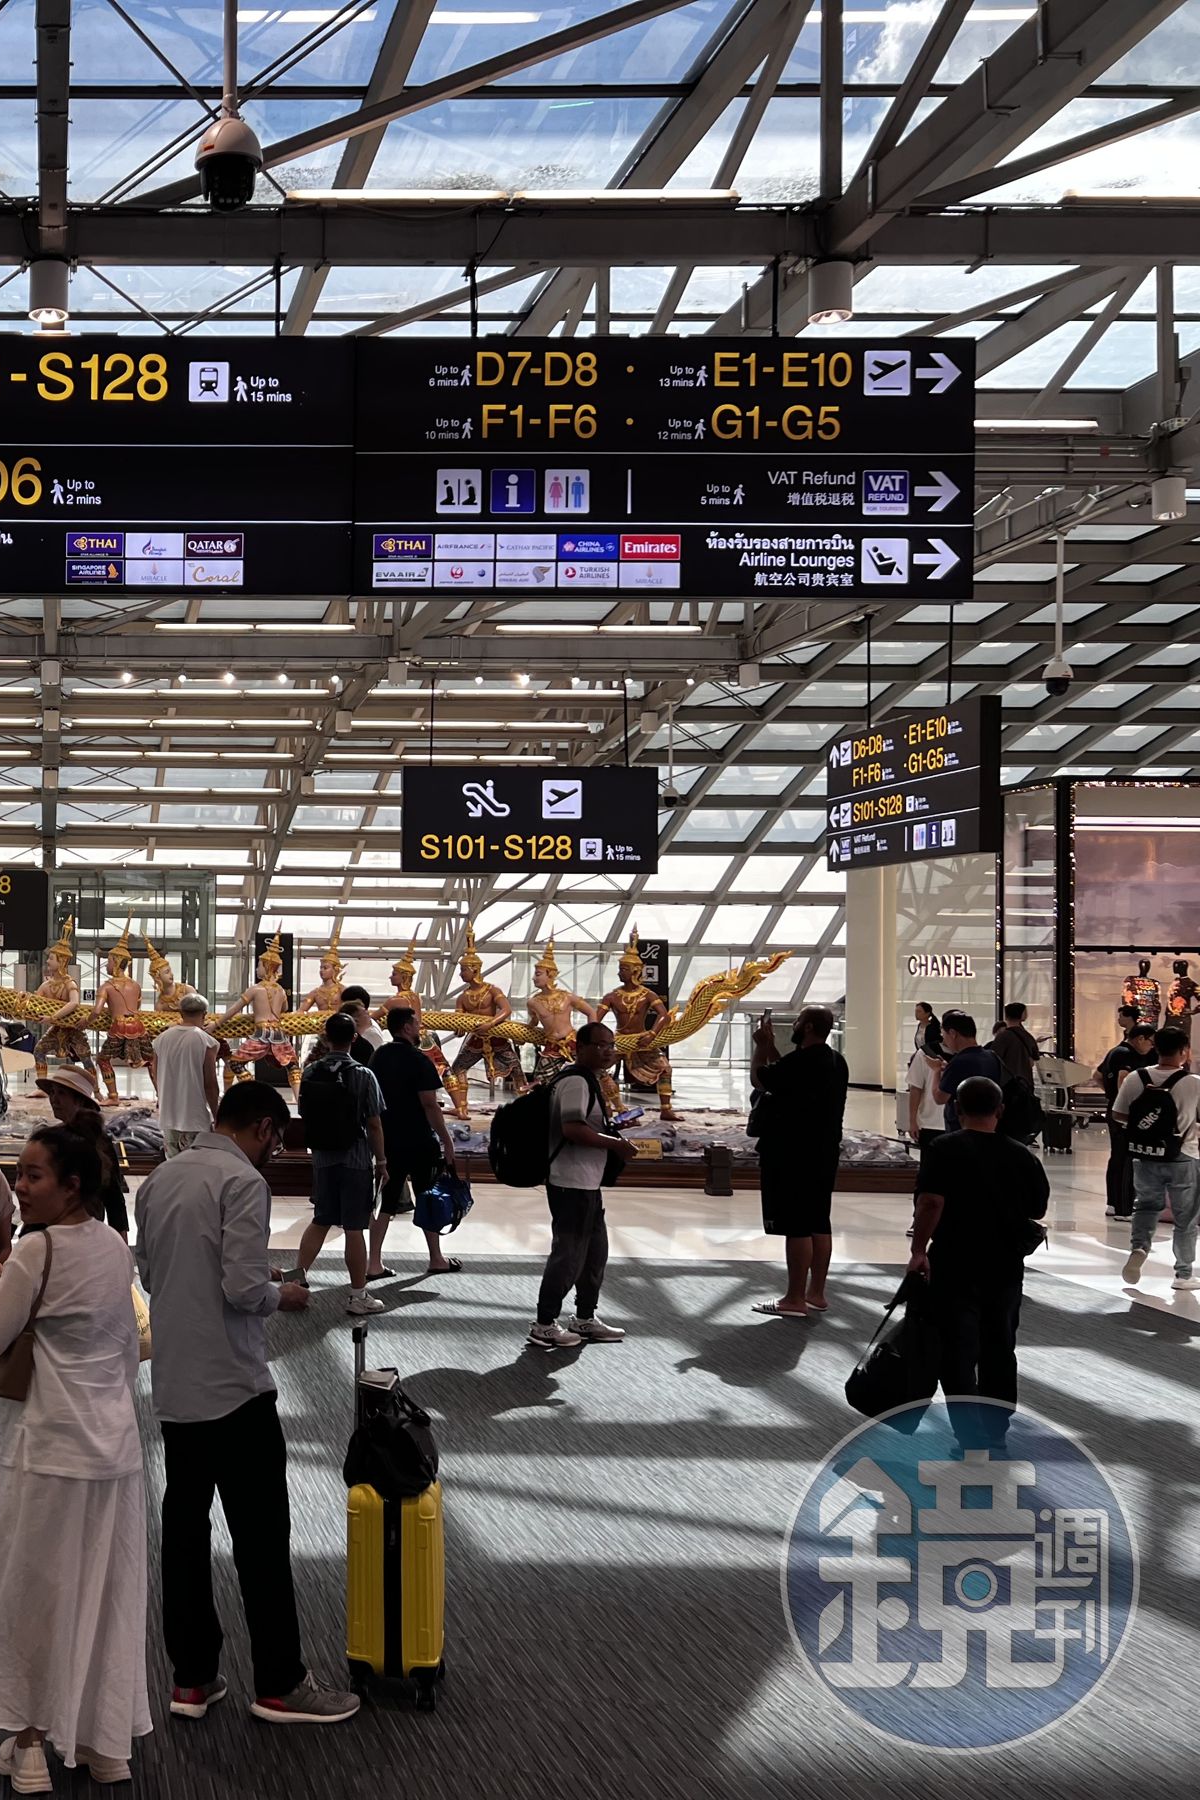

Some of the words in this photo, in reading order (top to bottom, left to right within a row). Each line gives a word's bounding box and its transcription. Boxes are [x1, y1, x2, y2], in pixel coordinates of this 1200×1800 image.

[435, 365, 448, 376] Up
[449, 365, 459, 374] to
[476, 351, 598, 387] D7-D8
[670, 365, 683, 376] Up
[685, 366, 694, 374] to
[714, 352, 852, 388] E1-E10
[250, 376, 266, 389] Up
[268, 377, 279, 387] to
[429, 377, 435, 387] 6
[437, 377, 459, 387] mins
[659, 378, 670, 387] 13
[672, 378, 694, 387] mins
[250, 392, 264, 402] 15
[266, 391, 292, 402] mins
[436, 418, 448, 429] Up
[450, 418, 460, 427] to
[482, 404, 597, 438] F1-F6
[668, 418, 682, 429] Up
[683, 419, 692, 428] to
[711, 403, 841, 440] G1-G5
[425, 431, 436, 440] 10
[438, 430, 460, 440] mins
[657, 431, 668, 440] 12
[670, 430, 692, 440] mins
[767, 471, 798, 484] VAT
[802, 471, 856, 485] Refund
[868, 475, 904, 491] VAT
[66, 479, 82, 492] Up
[84, 480, 95, 490] to
[706, 484, 719, 494] Up
[721, 484, 730, 492] to
[66, 495, 74, 505] 2
[76, 495, 101, 505] mins
[701, 496, 707, 505] 5
[708, 495, 730, 505] mins
[787, 492, 855, 506] 增值税退税
[868, 493, 904, 501] REFUND
[88, 538, 117, 549] THAI
[188, 539, 223, 550] QATAR
[397, 540, 425, 550] THAI
[624, 541, 677, 554] Emirates
[706, 531, 854, 551] ห้องรับรองสายการบิน
[739, 553, 786, 567] Airline
[790, 553, 854, 569] Lounges
[192, 566, 240, 583] Coral
[754, 572, 854, 587] 航空公司贵宾室
[908, 716, 947, 745] E1-E10
[853, 735, 882, 760] D6-D8
[908, 747, 944, 773] G1-G5
[853, 763, 881, 787] F1-F6
[420, 834, 573, 860] S101-S128
[615, 845, 625, 853] Up
[907, 954, 974, 977] CHANEL
